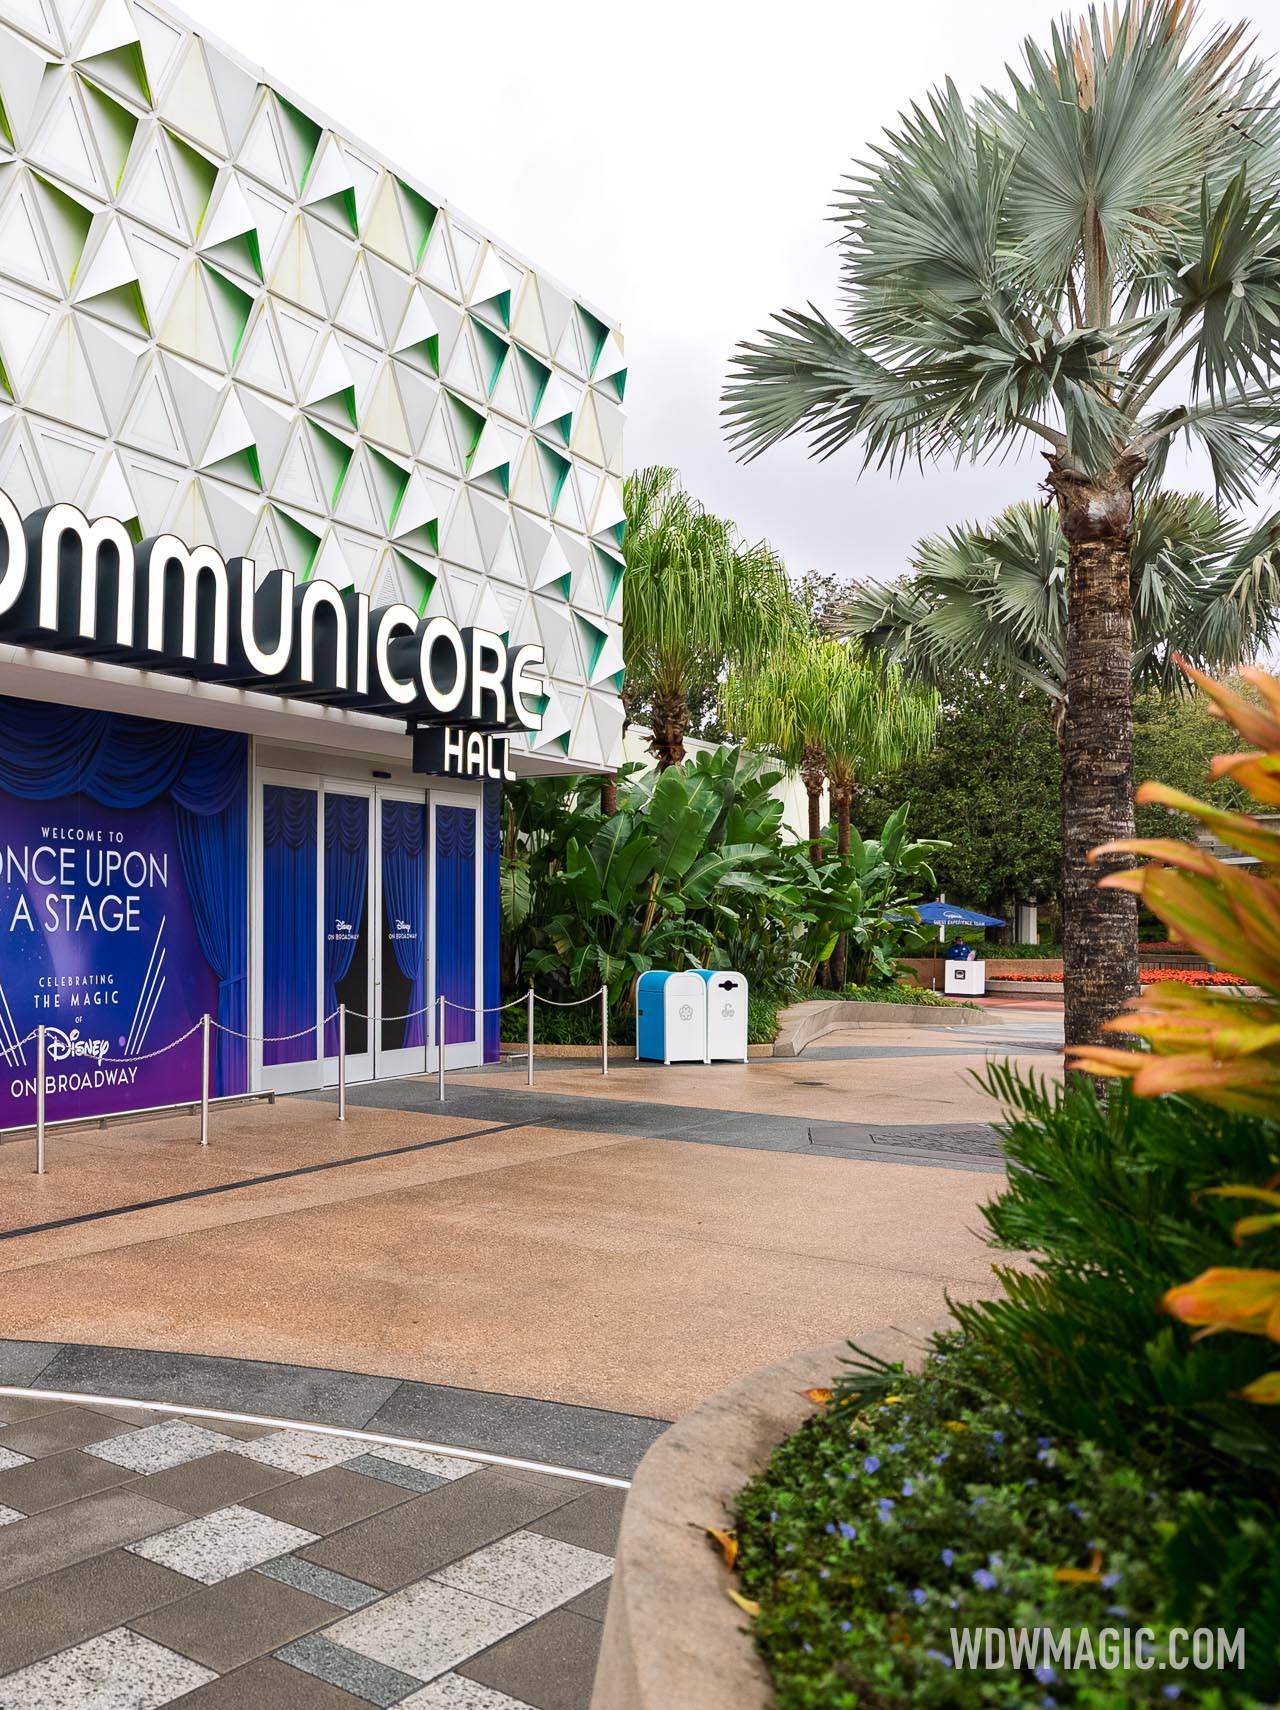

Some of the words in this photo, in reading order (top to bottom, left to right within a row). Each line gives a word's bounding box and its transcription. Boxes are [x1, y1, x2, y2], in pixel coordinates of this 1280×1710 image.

[444, 726, 517, 782] HALL
[41, 826, 102, 842] WELCOME
[109, 831, 124, 843] TO
[86, 848, 168, 889] UPON
[9, 893, 35, 932] A
[44, 893, 141, 933] STAGE
[38, 974, 114, 988] CELEBRATING
[33, 994, 61, 1009] THE
[70, 990, 119, 1007] MAGIC
[74, 1015, 83, 1024] OF
[10, 1077, 38, 1098] ON
[45, 1066, 138, 1094] BROADWAY
